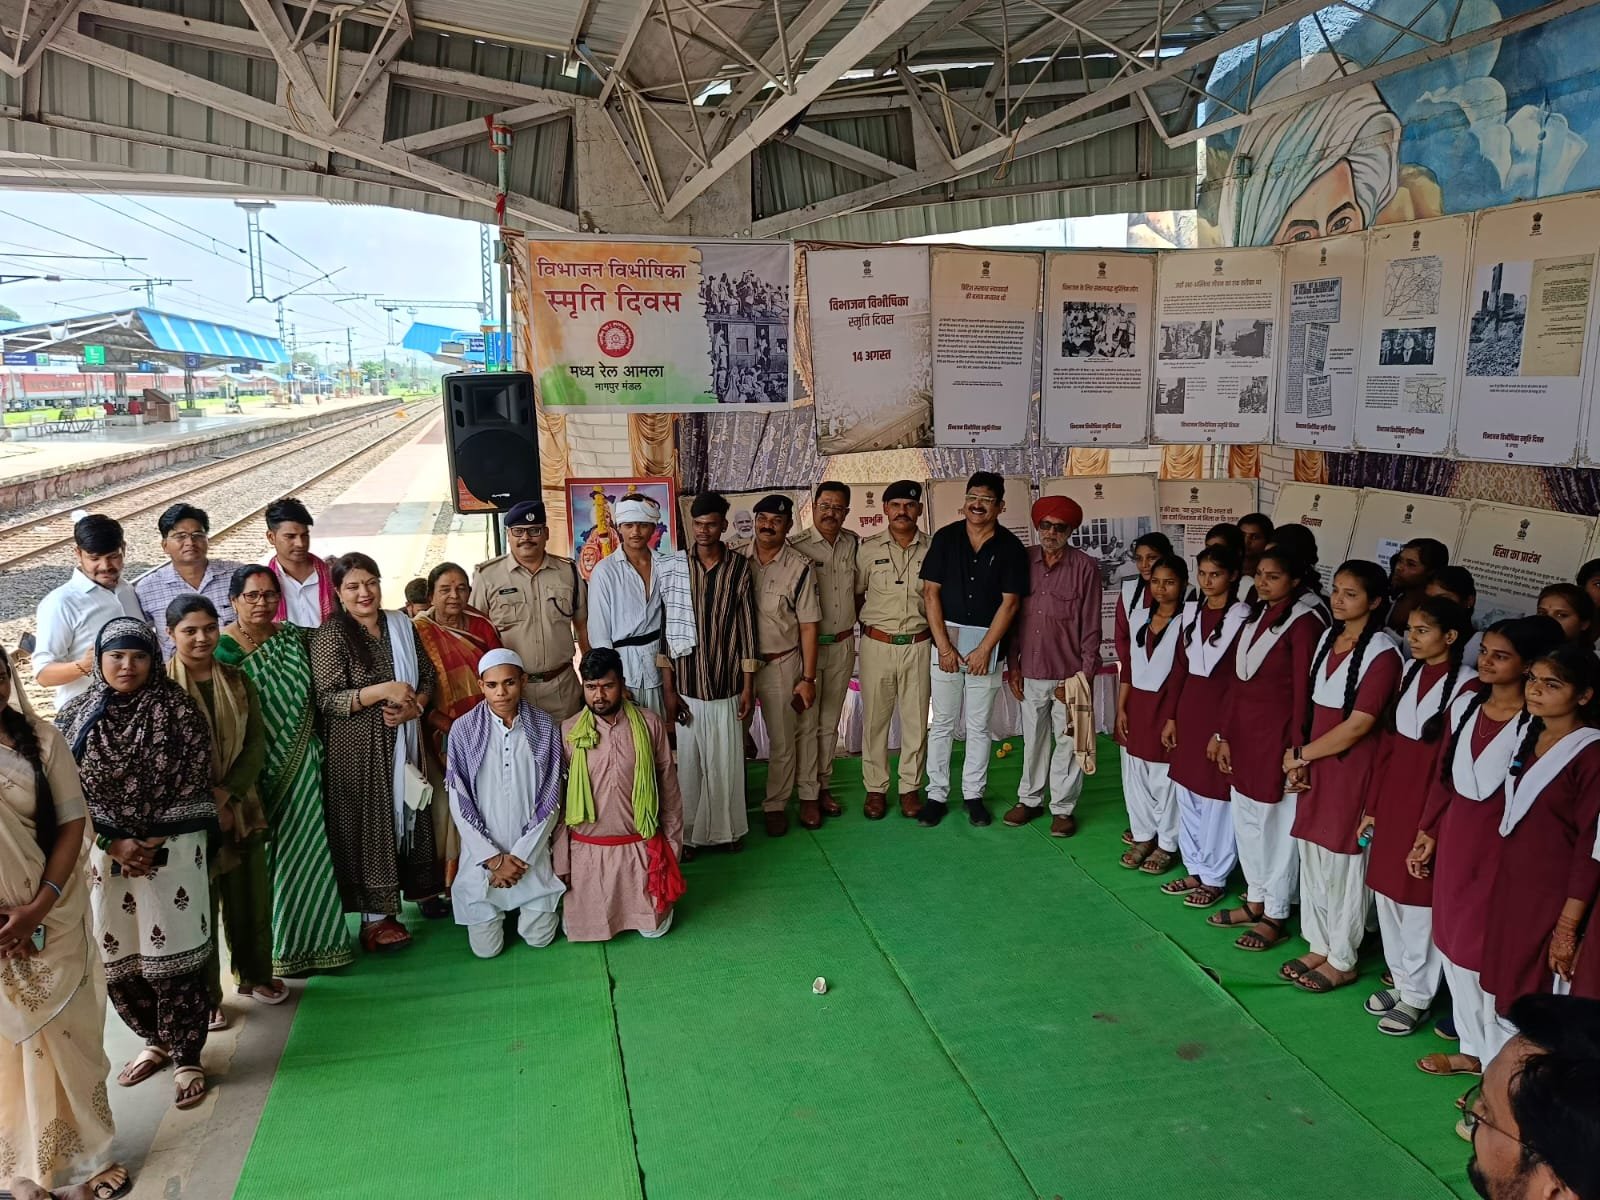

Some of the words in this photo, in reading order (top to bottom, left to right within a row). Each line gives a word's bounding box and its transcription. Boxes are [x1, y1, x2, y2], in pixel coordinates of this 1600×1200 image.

[537, 257, 604, 279] विभाजन
[608, 257, 687, 280] विभीषिका
[545, 283, 607, 319] स्मृति
[615, 283, 683, 316] दिवस
[829, 297, 866, 311] विभाजन
[867, 294, 909, 309] विभीषिका
[848, 312, 870, 330] स्मृति
[872, 312, 895, 326] दिवस
[852, 351, 863, 362] 14
[865, 349, 892, 361] अगस्त
[569, 364, 595, 378] मध्य
[599, 361, 618, 378] रेल
[623, 364, 665, 379] आमला
[594, 382, 620, 394] नागपुर
[622, 380, 642, 392] मंडल
[859, 513, 883, 528] पृष्ठभूमि
[1493, 544, 1509, 559] हिंसा
[1509, 549, 1521, 561] का
[1520, 550, 1542, 565] प्रारंभ
